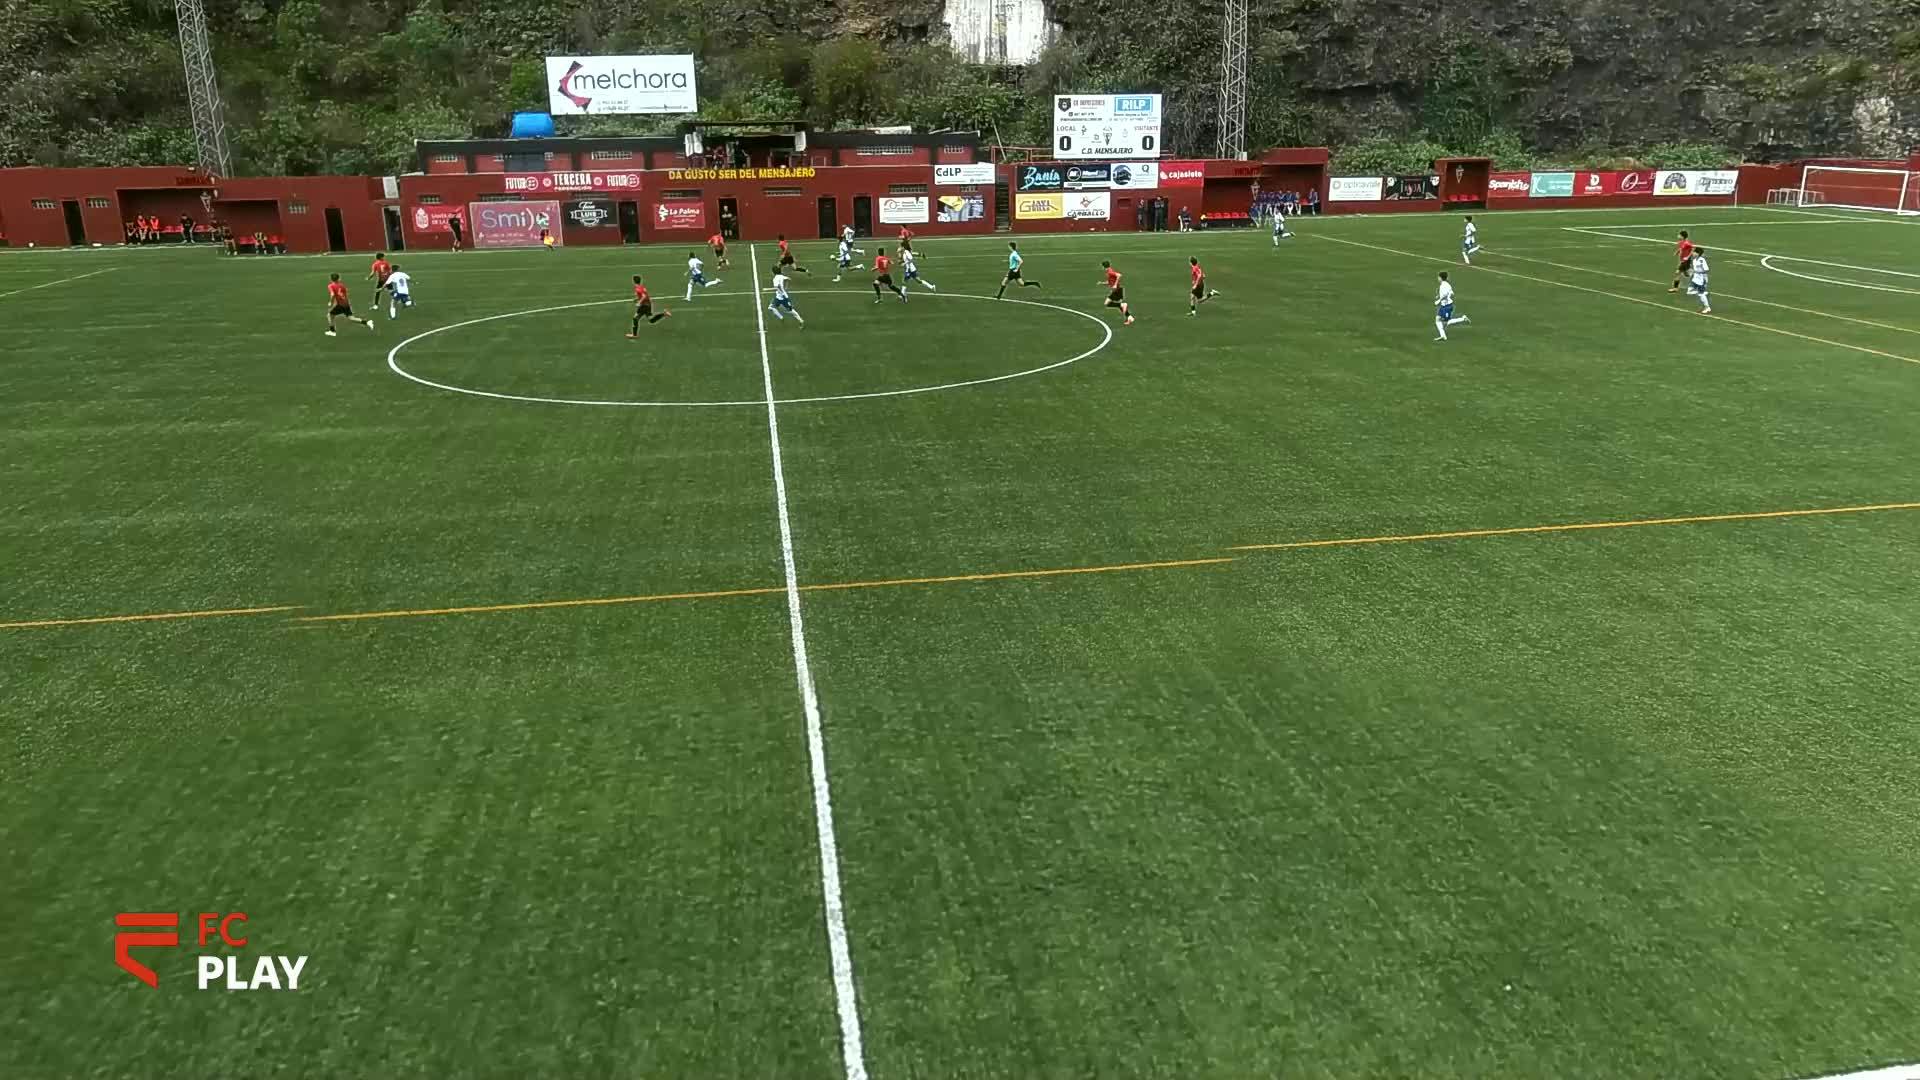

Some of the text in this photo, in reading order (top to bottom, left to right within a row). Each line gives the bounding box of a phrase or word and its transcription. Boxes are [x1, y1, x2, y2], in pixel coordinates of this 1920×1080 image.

[573, 68, 687, 89] melchora
[1059, 136, 1072, 151] 0
[1142, 135, 1154, 151] 0
[1095, 147, 1133, 155] MENSAJERO
[668, 168, 816, 180] DA GUSTO SER DEL MENSAJERO
[936, 167, 962, 177] CdLP
[553, 173, 592, 186] TERCERA
[679, 207, 700, 215] Palma
